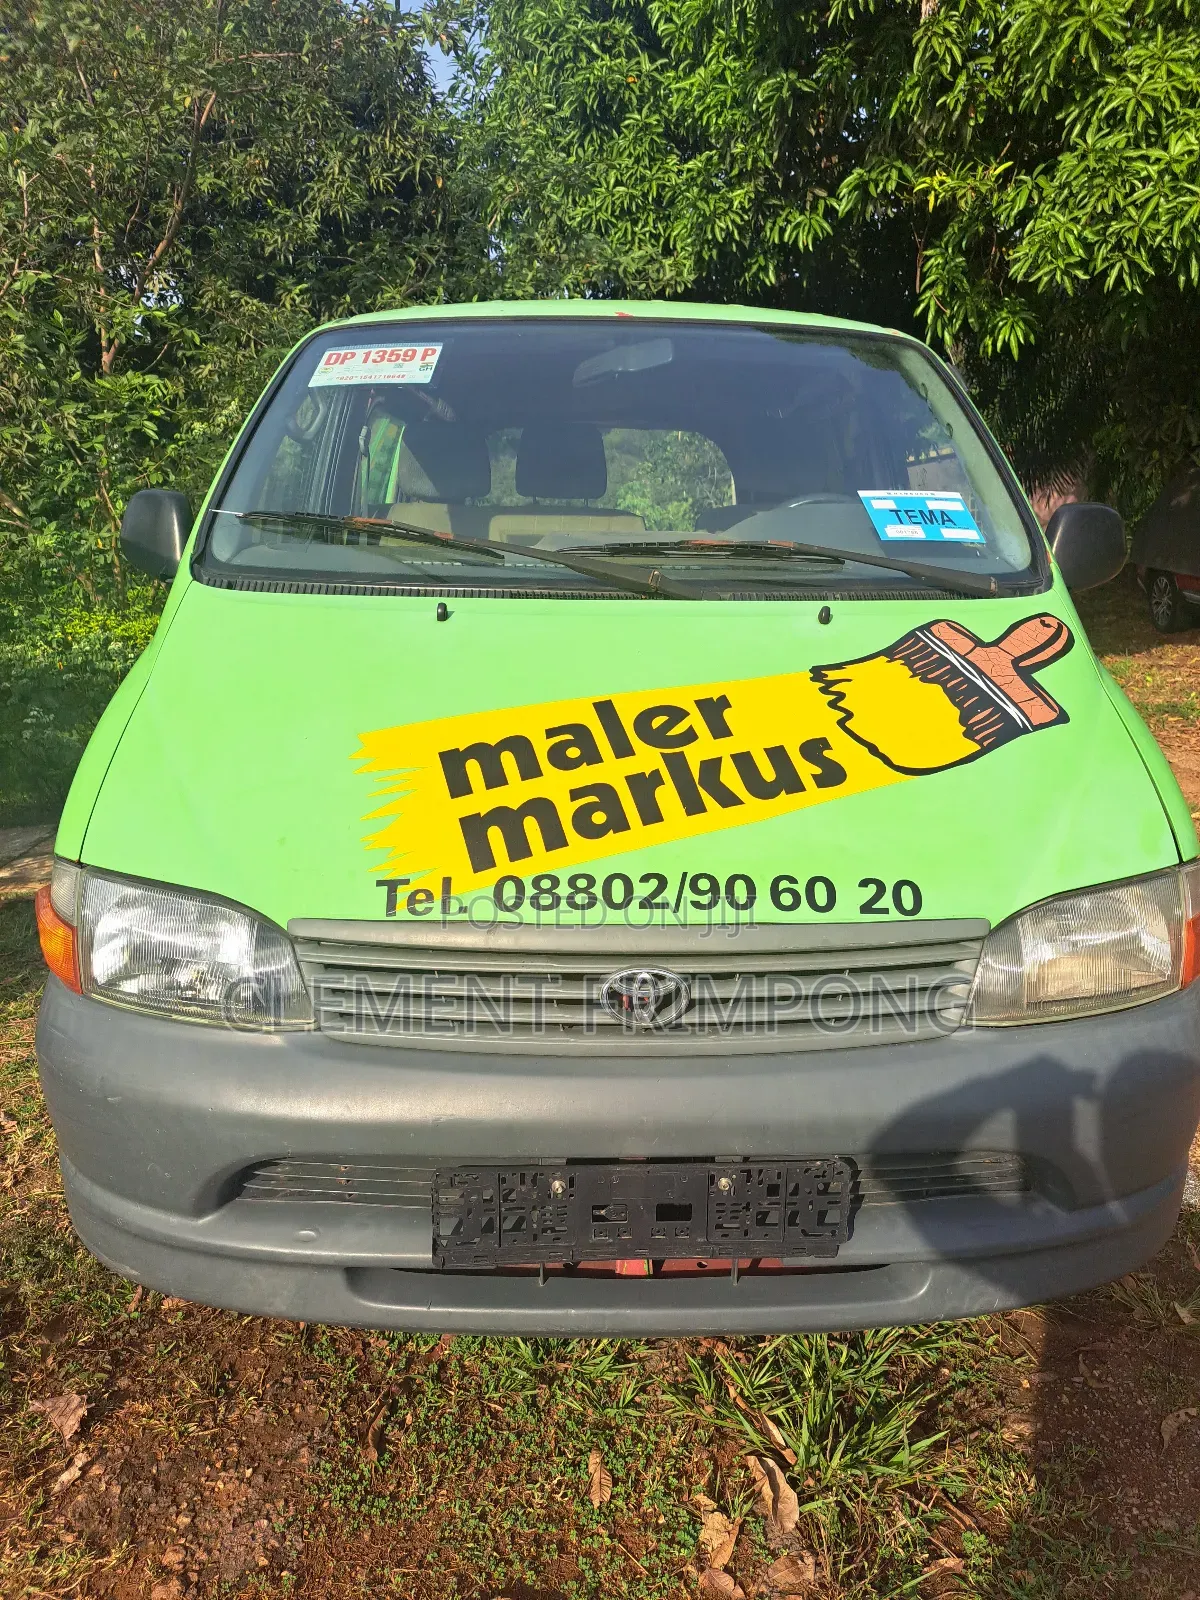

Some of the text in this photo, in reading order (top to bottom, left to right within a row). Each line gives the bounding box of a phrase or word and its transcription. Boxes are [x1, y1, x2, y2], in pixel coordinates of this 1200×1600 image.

[324, 347, 437, 366] DP 1359 P
[889, 509, 957, 526] TEMA
[438, 694, 734, 799] maler
[458, 736, 848, 874] markus
[376, 871, 923, 918] Tel. 08802/90 60 20
